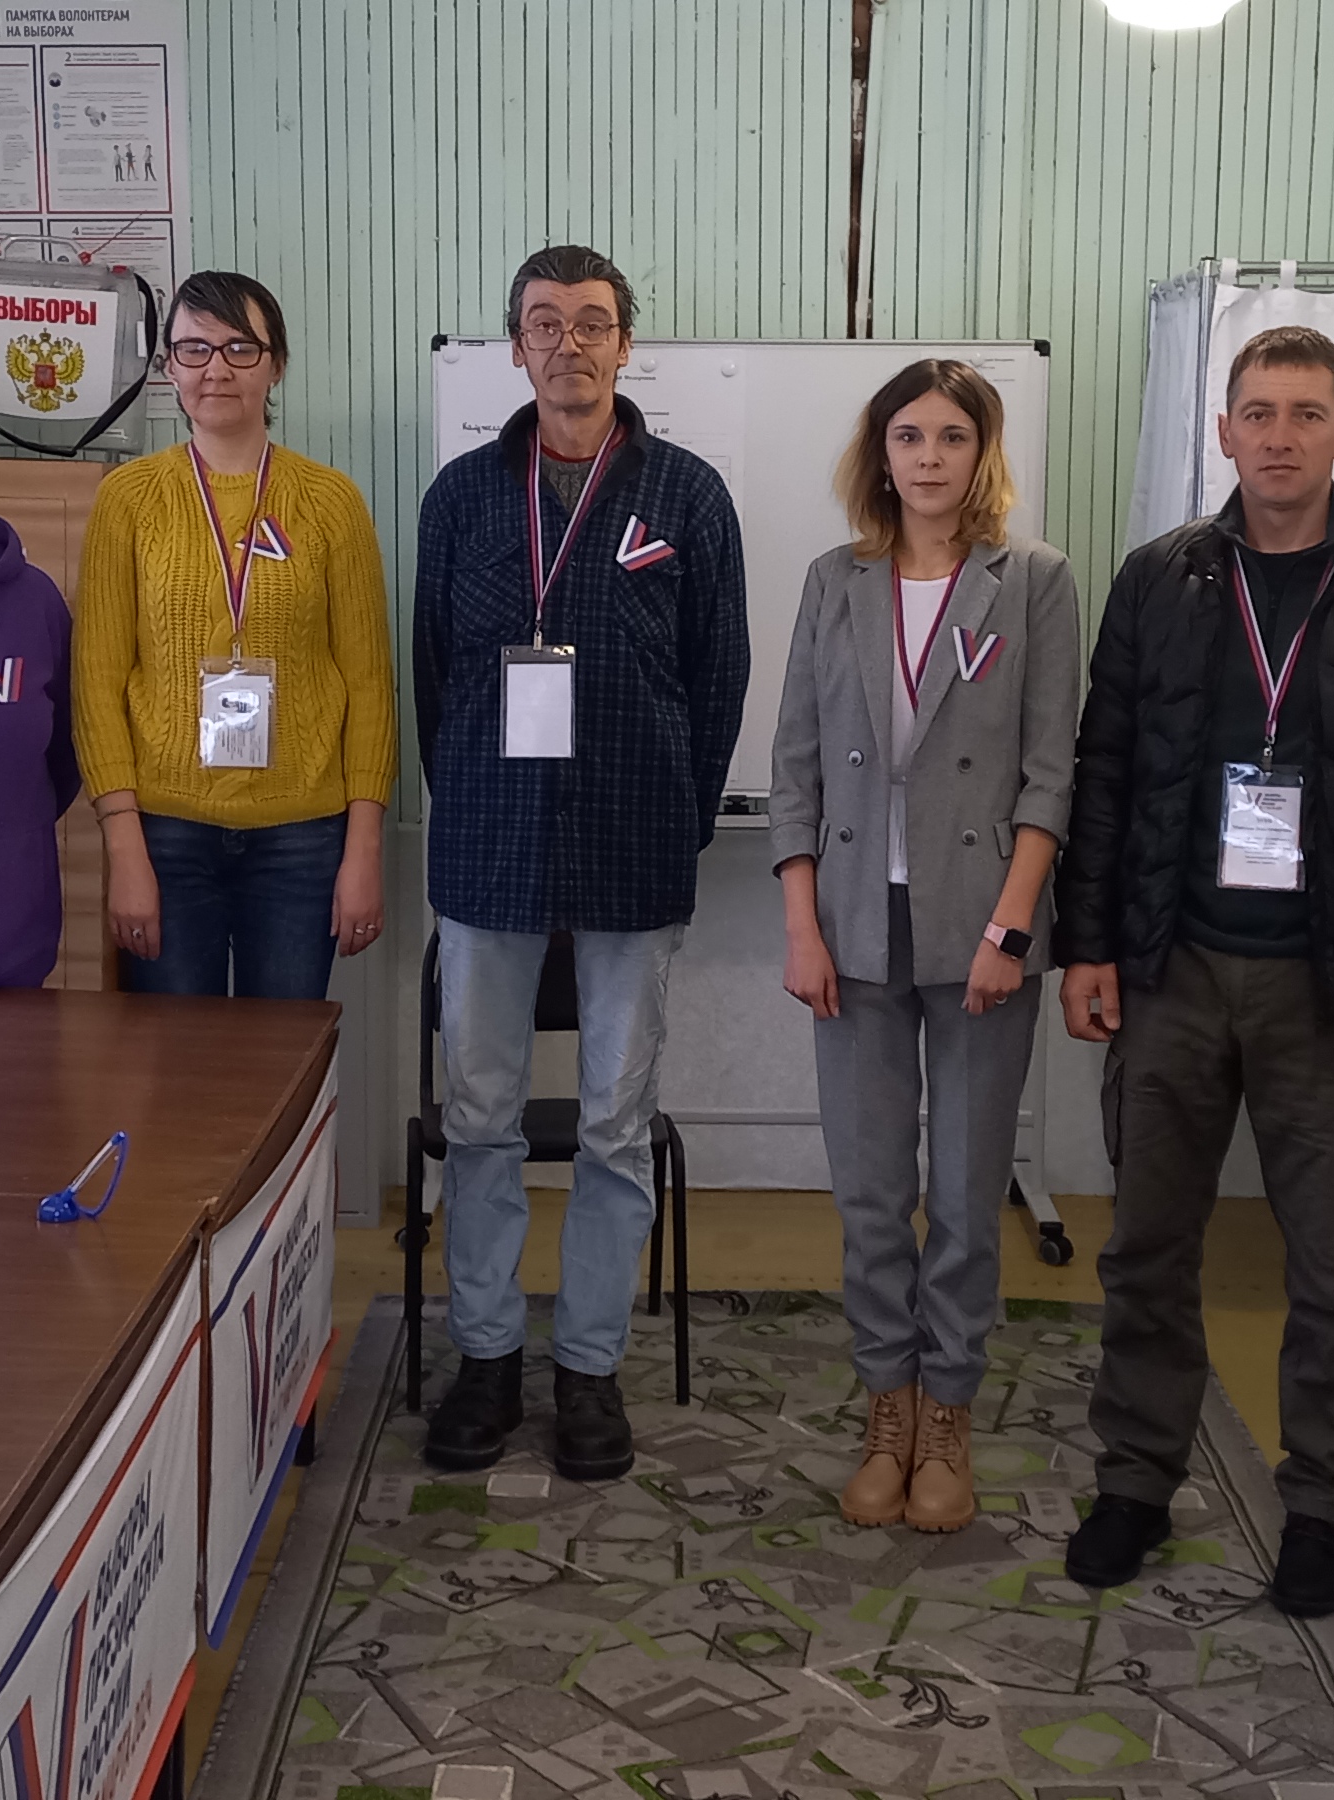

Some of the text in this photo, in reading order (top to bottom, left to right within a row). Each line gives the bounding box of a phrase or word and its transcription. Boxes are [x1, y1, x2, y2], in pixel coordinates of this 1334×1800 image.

[5, 9, 130, 22] ПАМЯТКА ВОЛОНТЕРАМ
[6, 26, 75, 38] НА ВЫБОРАХ
[65, 52, 72, 62] 2
[72, 226, 80, 236] 4
[93, 1469, 151, 1631] ВЫБОРЫ
[85, 1512, 165, 1724] ПРЕЗИДЕНТА
[77, 1647, 133, 1800] РОССИИ
